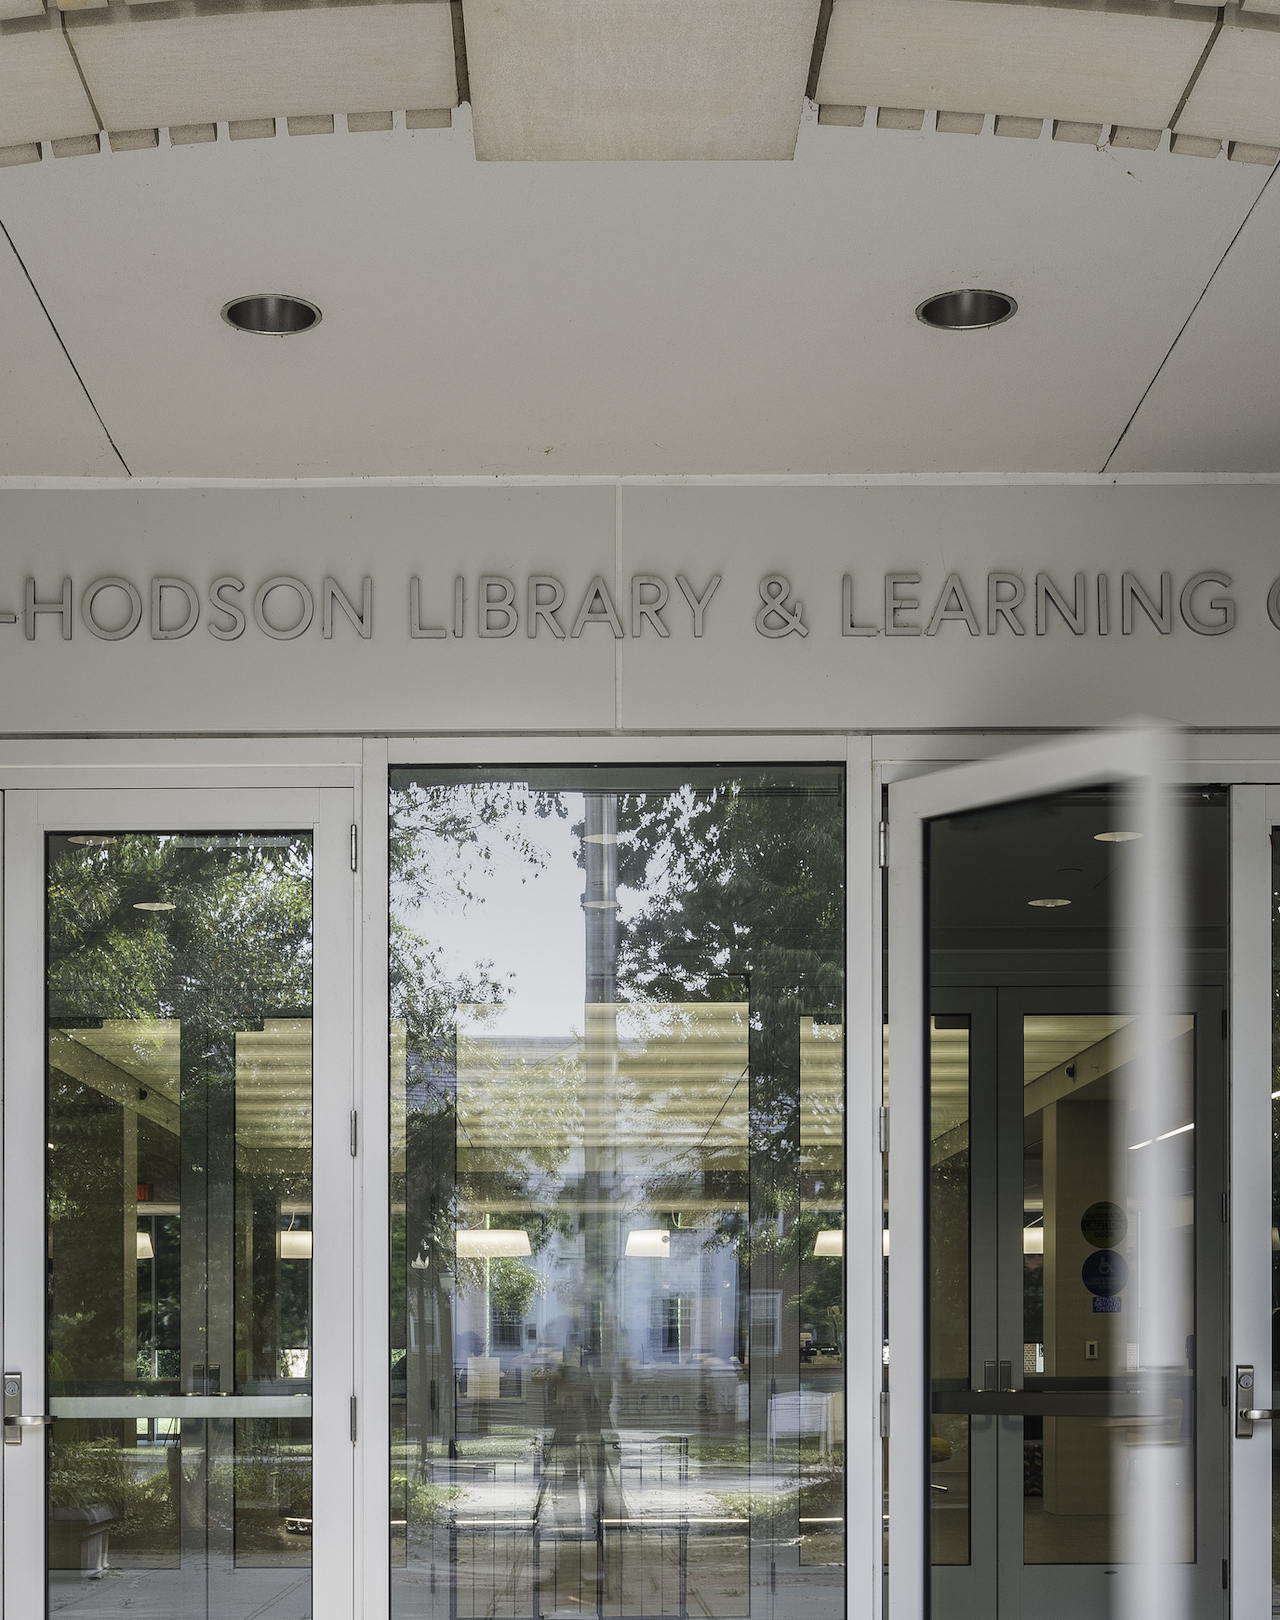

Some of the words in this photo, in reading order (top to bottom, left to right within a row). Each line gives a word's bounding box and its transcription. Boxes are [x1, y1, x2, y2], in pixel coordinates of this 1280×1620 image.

[409, 573, 724, 642] LIBRARY
[754, 573, 810, 640] &
[839, 571, 1236, 640] LEARNING
